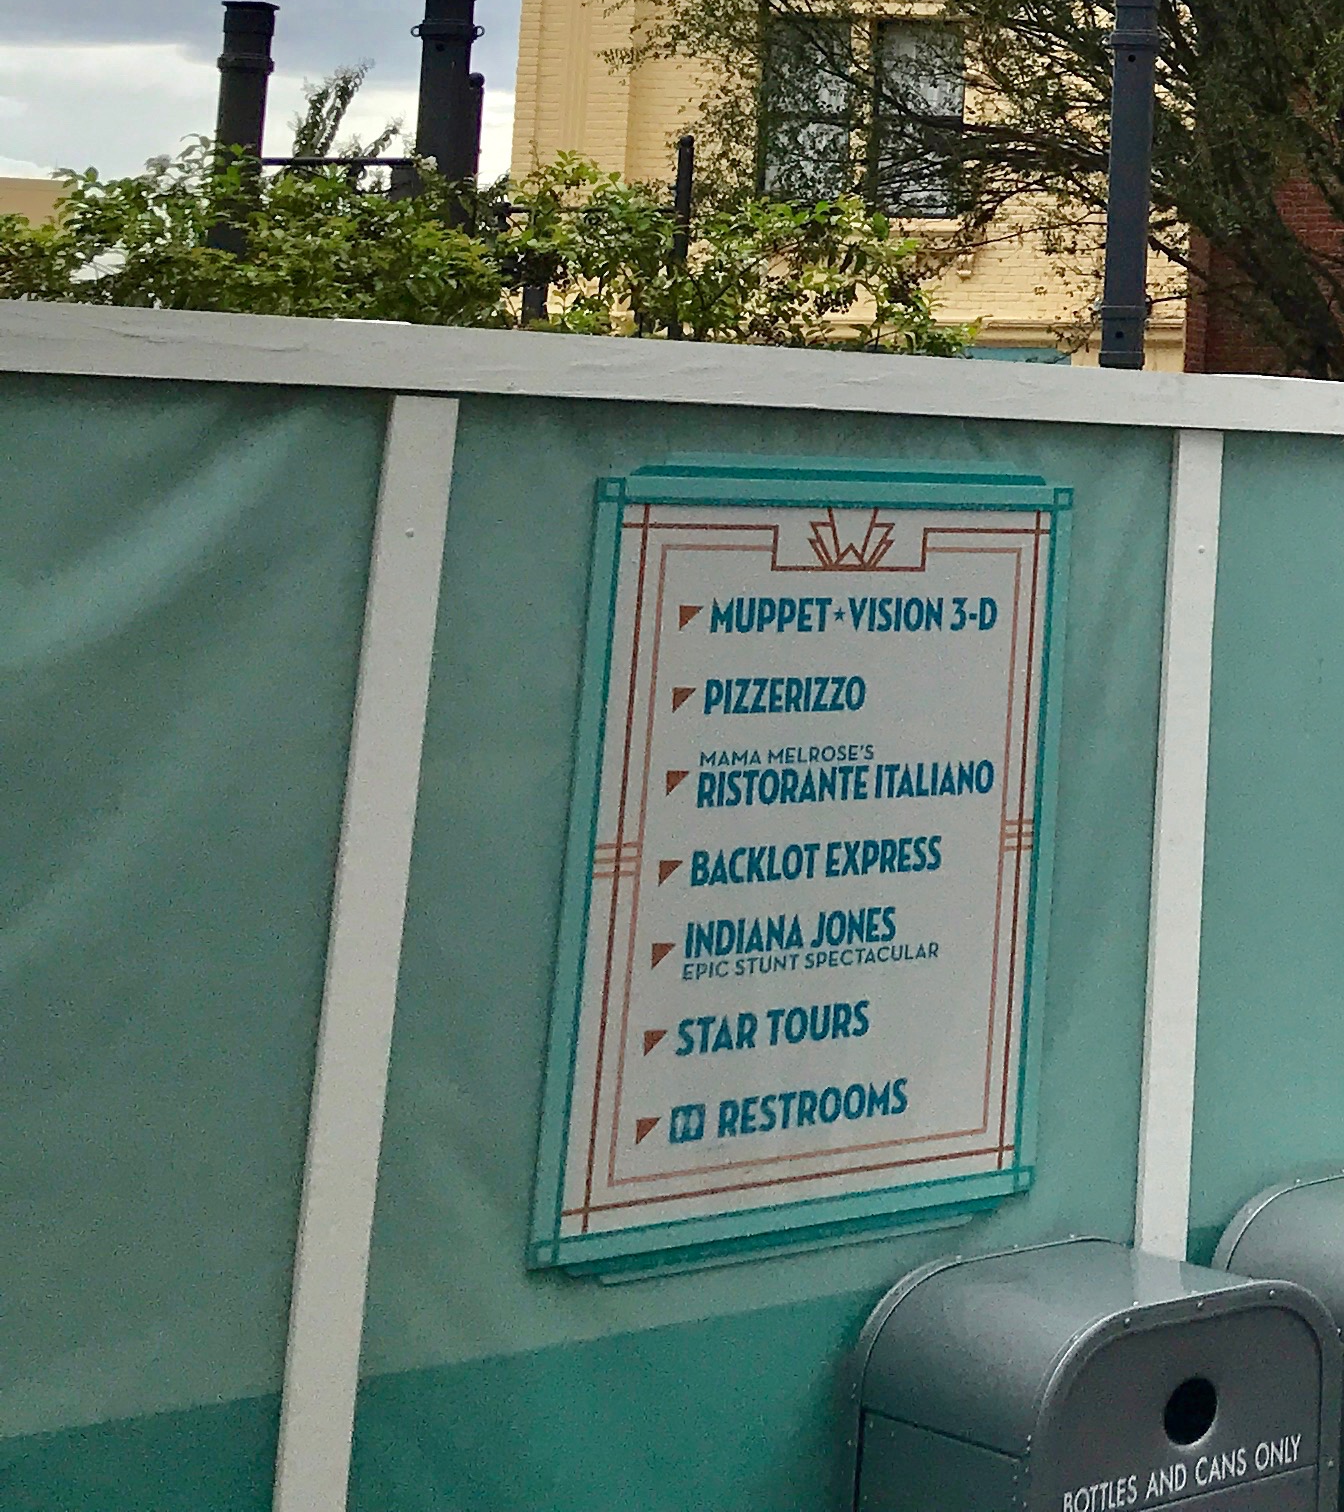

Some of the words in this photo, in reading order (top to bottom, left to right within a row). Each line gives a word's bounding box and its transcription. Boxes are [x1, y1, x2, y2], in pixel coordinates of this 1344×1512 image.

[950, 597, 997, 631] 3-D
[703, 676, 865, 715] PIZZERIZZO
[700, 750, 761, 766] MAMA
[768, 745, 874, 764] MELROSE'S
[697, 765, 869, 808] RISTORANTE
[874, 760, 995, 798] ITALIANO
[690, 843, 820, 886] BACKLOT
[825, 836, 942, 877] EXPRESS
[685, 914, 804, 959] INDIANA
[810, 906, 897, 949] JONES
[682, 962, 729, 981] EPIC
[734, 954, 799, 977] STUNT
[804, 942, 940, 969] SPECTACULAR
[675, 1013, 758, 1056] STAR
[766, 1000, 870, 1046] TOURS
[717, 1078, 908, 1138] RESTROOMS
[1063, 1475, 1137, 1512] BOTTLES
[1146, 1462, 1187, 1499] AND
[1195, 1447, 1247, 1486] CANS
[1255, 1434, 1302, 1472] ONLY
